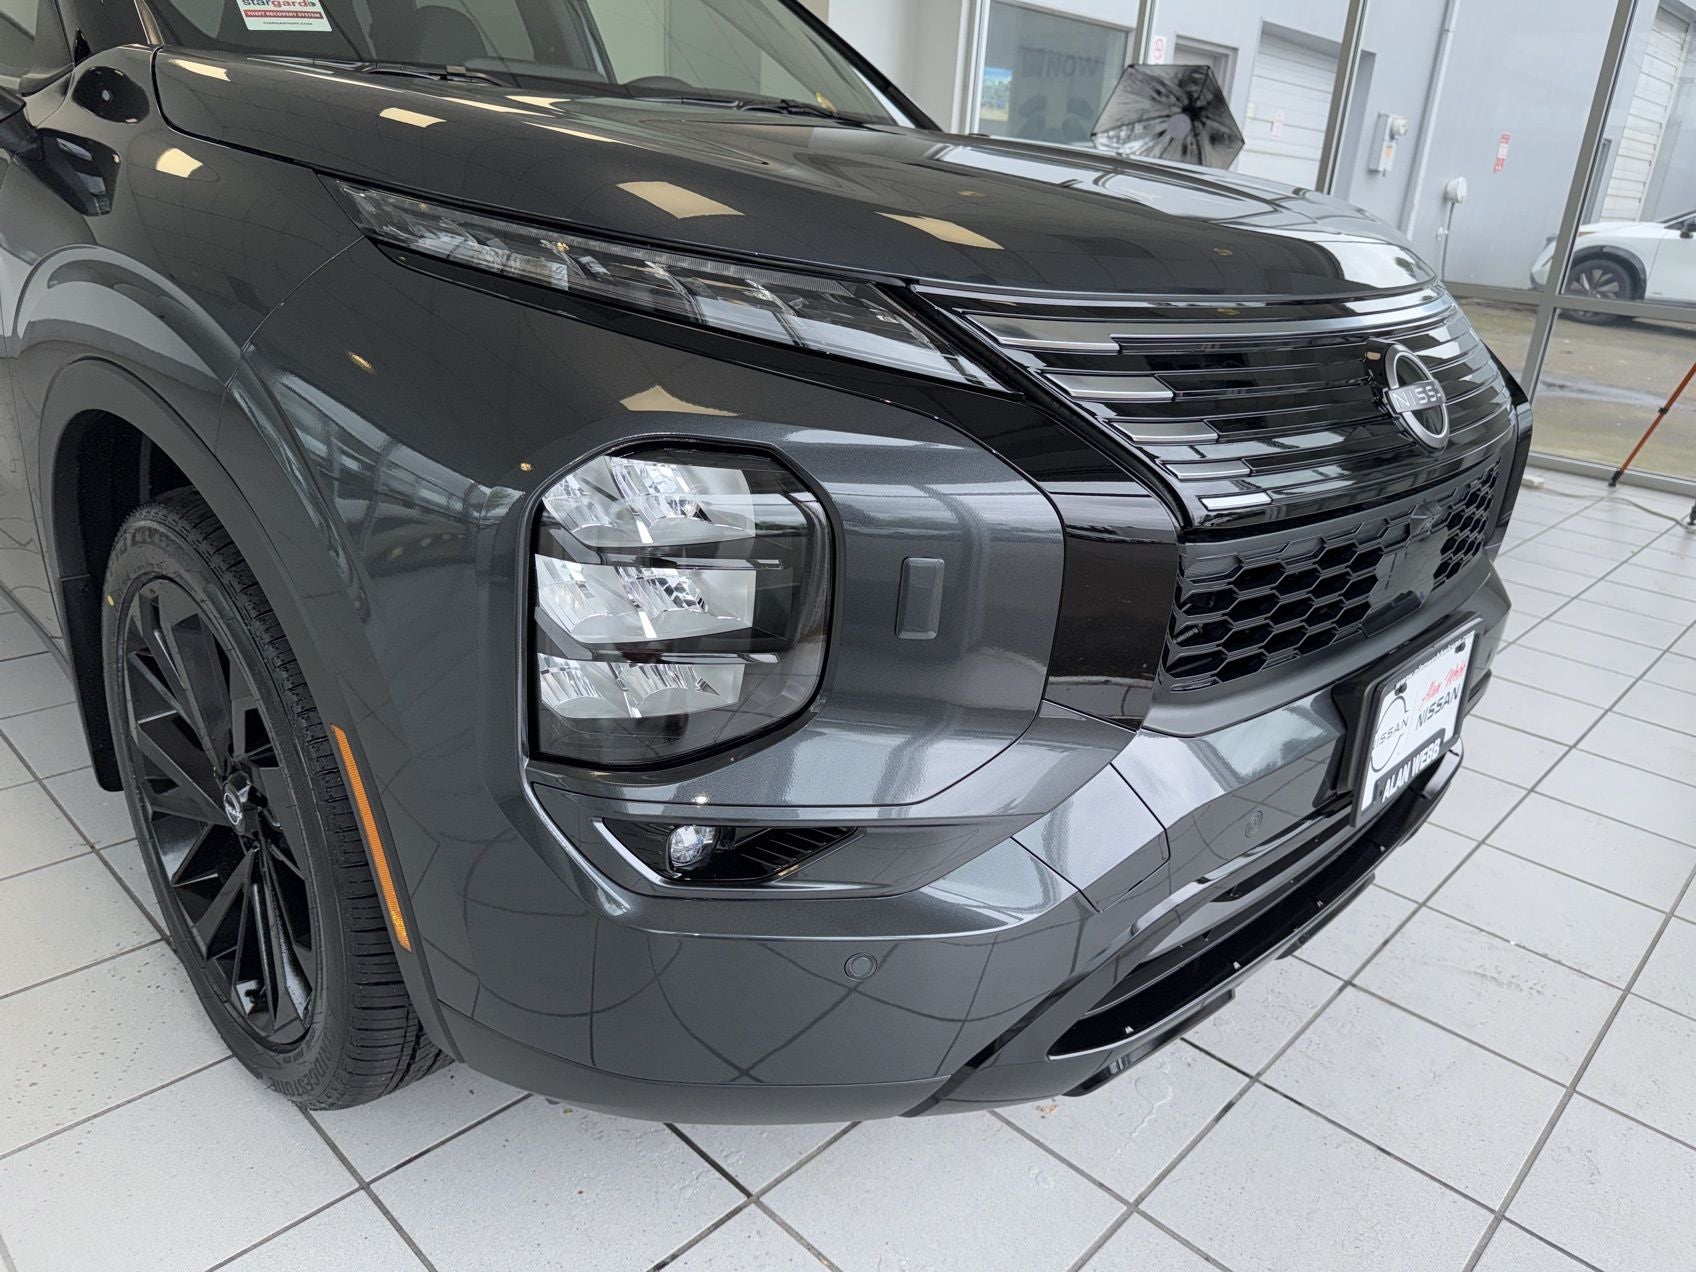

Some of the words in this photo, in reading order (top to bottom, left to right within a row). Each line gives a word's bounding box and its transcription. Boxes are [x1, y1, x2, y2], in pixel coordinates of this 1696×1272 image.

[1416, 683, 1461, 730] NISSAN
[1382, 761, 1412, 803] ALAN
[1411, 737, 1441, 778] WEBB
